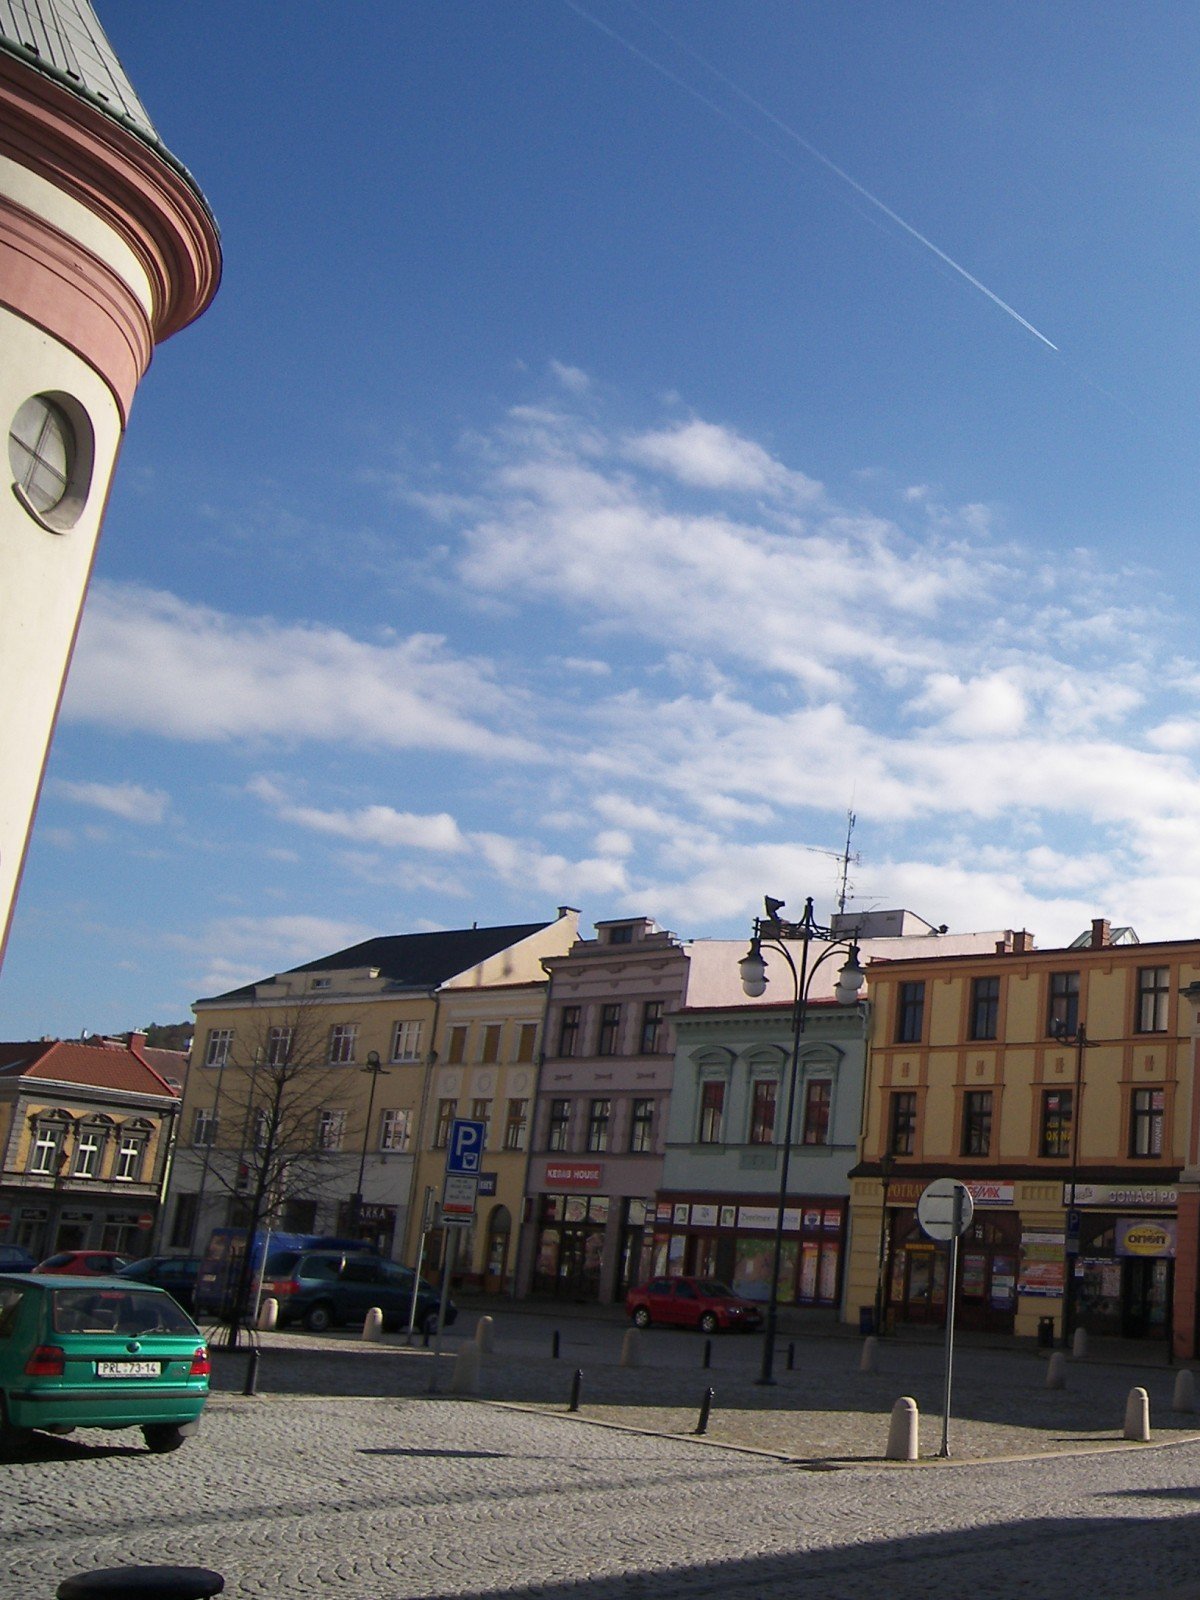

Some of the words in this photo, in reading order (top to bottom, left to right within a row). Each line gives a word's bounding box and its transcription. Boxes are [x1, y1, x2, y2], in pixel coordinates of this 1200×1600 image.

[456, 1125, 478, 1156] P
[547, 1169, 572, 1179] KEBAB
[573, 1170, 600, 1180] HOUSE
[103, 1363, 121, 1374] PRL
[129, 1363, 156, 1374] 73-14
